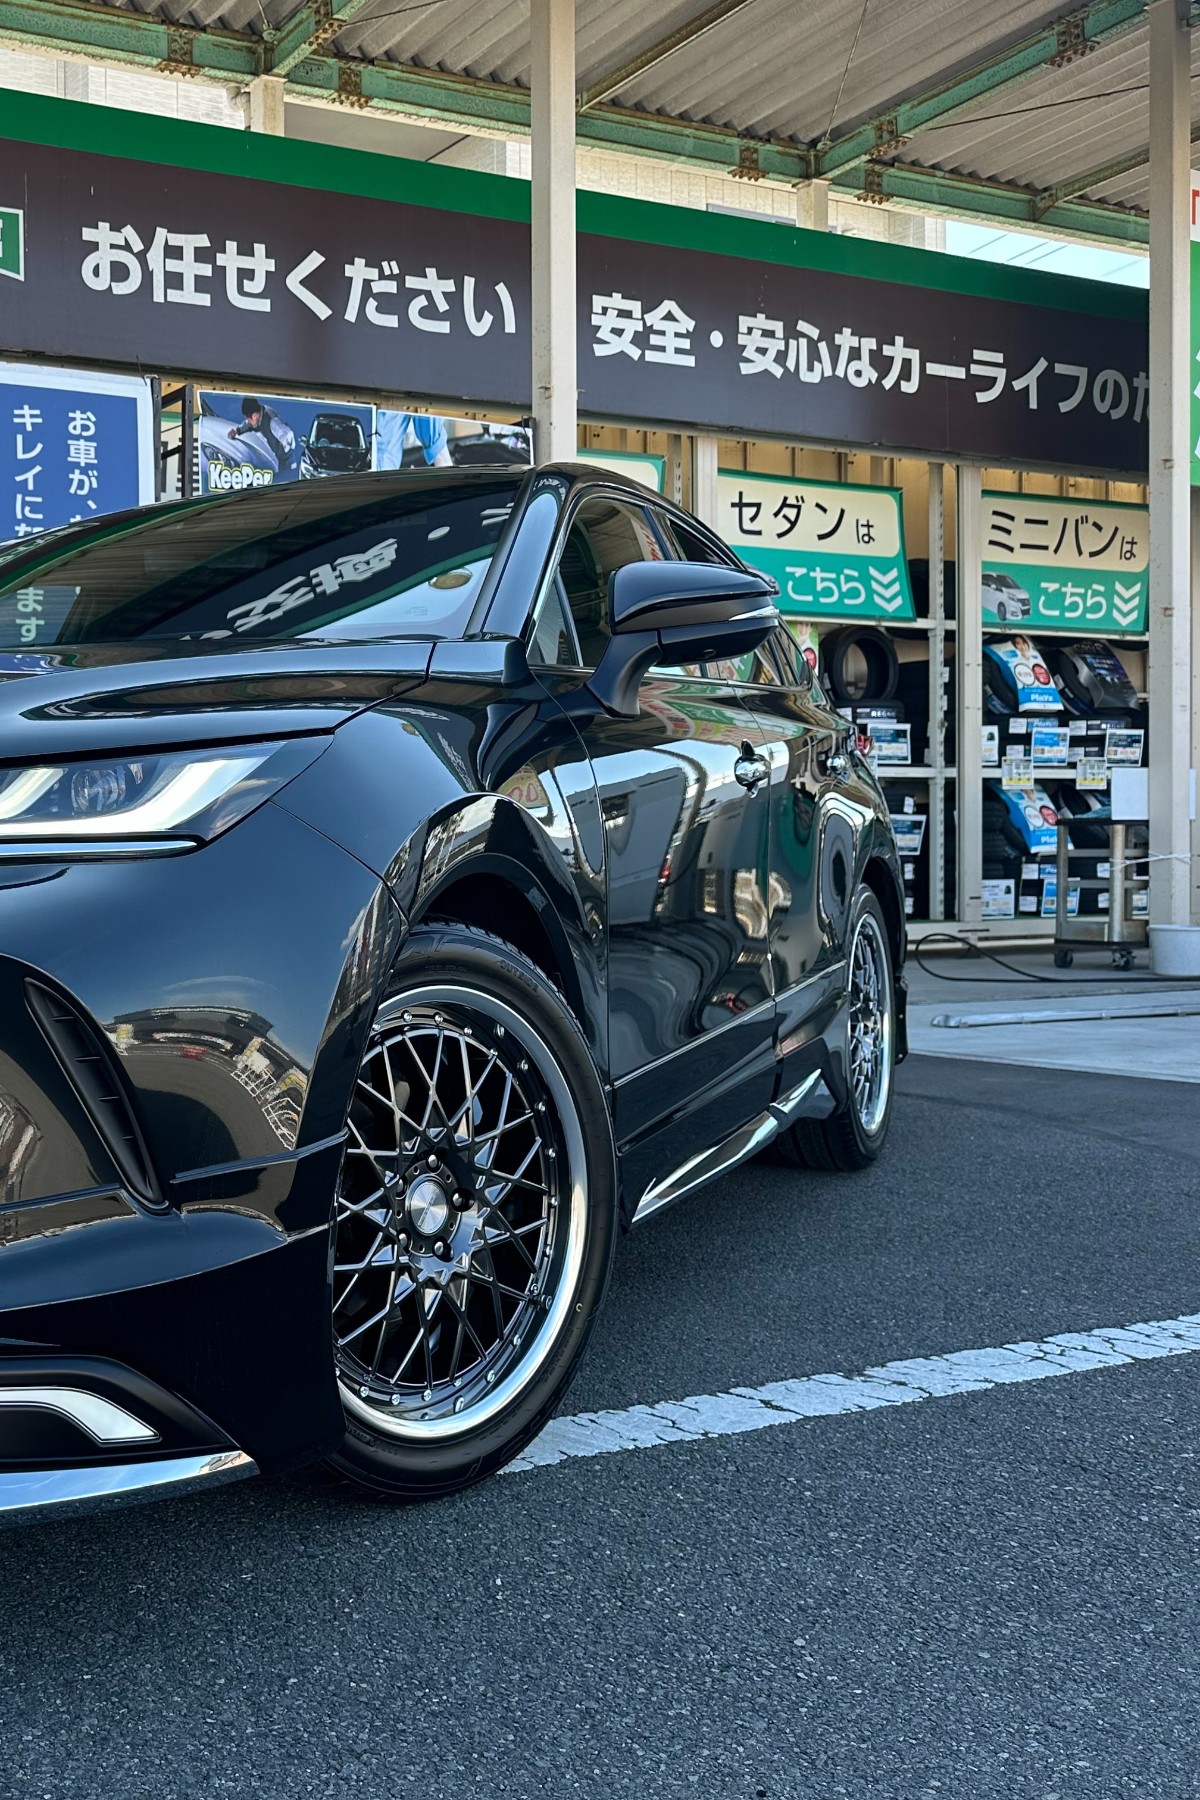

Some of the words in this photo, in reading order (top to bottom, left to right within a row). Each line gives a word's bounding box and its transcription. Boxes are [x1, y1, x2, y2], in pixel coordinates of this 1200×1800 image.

[80, 221, 517, 337] お任せください
[208, 461, 275, 492] KeePer
[731, 491, 875, 544] セダンは
[988, 510, 1138, 561] ミニバンは
[785, 566, 866, 605] こちら
[1038, 582, 1108, 619] こちら
